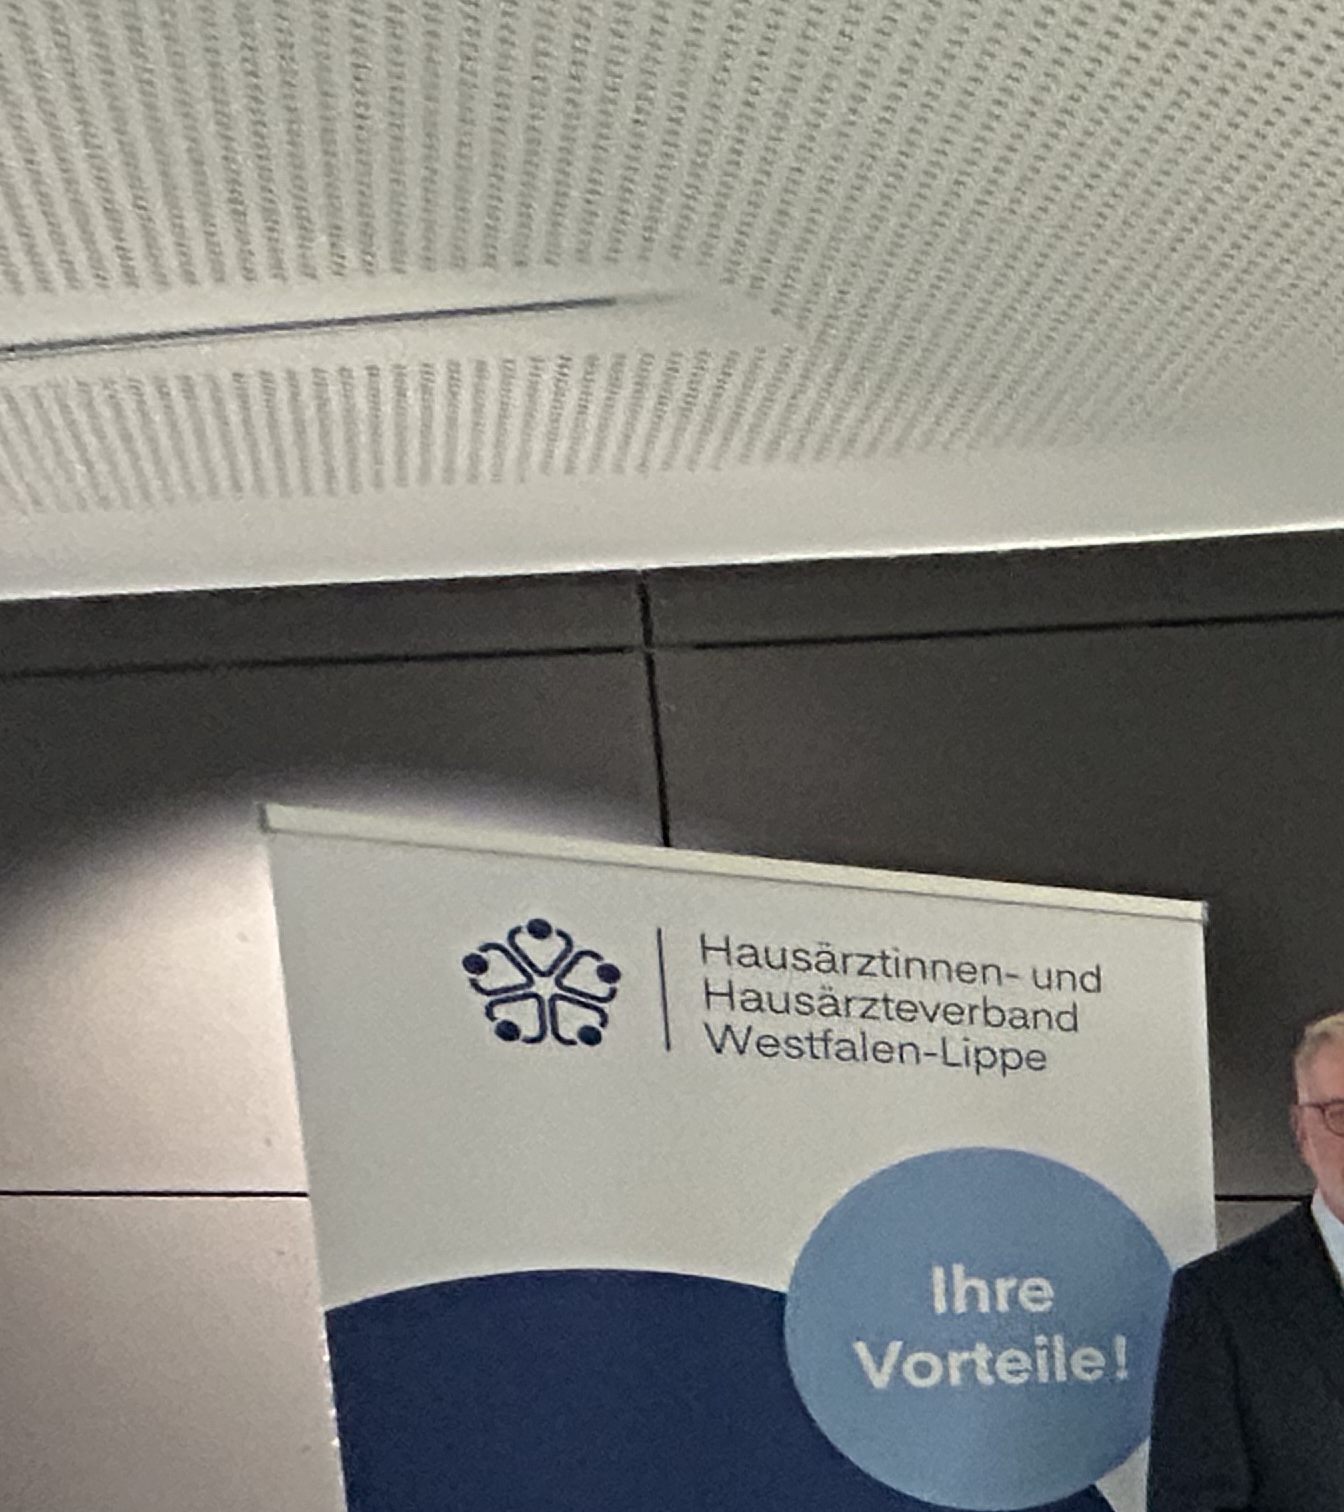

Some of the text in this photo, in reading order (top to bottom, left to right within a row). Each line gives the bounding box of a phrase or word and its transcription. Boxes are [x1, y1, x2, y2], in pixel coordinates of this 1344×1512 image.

[699, 932, 1102, 994] Hausärztinnen- und
[703, 977, 1079, 1033] Hausärzteverband
[703, 1021, 1047, 1078] Westfalen-Lippe
[932, 1263, 1055, 1316] Ihre
[852, 1334, 1128, 1390] Vorteile!
